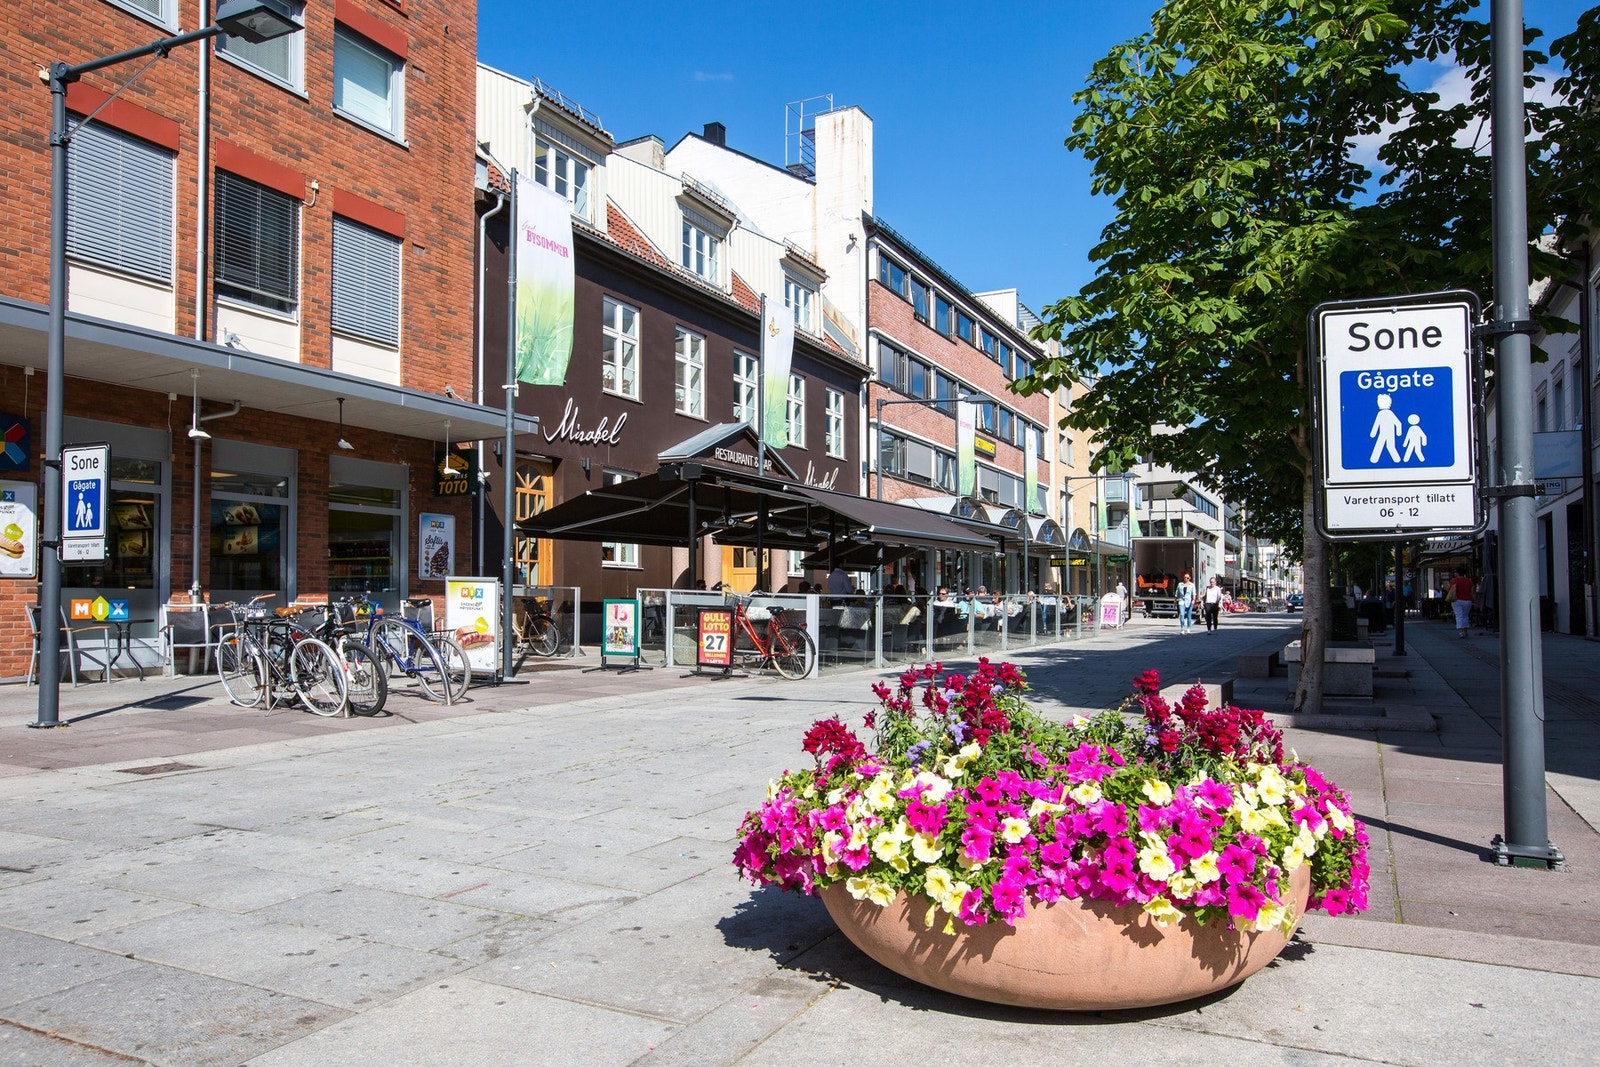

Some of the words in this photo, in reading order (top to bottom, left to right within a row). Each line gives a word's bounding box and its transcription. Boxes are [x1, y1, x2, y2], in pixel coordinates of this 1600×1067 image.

[526, 229, 569, 258] BYSOMMER
[1348, 322, 1442, 352] Sone
[1357, 370, 1434, 392] Gågate
[542, 397, 628, 444] Mirabel
[71, 455, 99, 471] Sone
[714, 447, 754, 467] RESTAURANT
[804, 460, 839, 491] Mirabel
[73, 481, 96, 492] Gågate
[439, 480, 468, 494] TOTO
[1344, 494, 1420, 505] Varetransport
[1426, 493, 1456, 503] tillatt
[1380, 508, 1395, 518] 06
[1408, 507, 1419, 517] 12
[72, 599, 127, 618] MIX
[703, 622, 730, 632] LOTTO
[705, 634, 725, 650] 27
